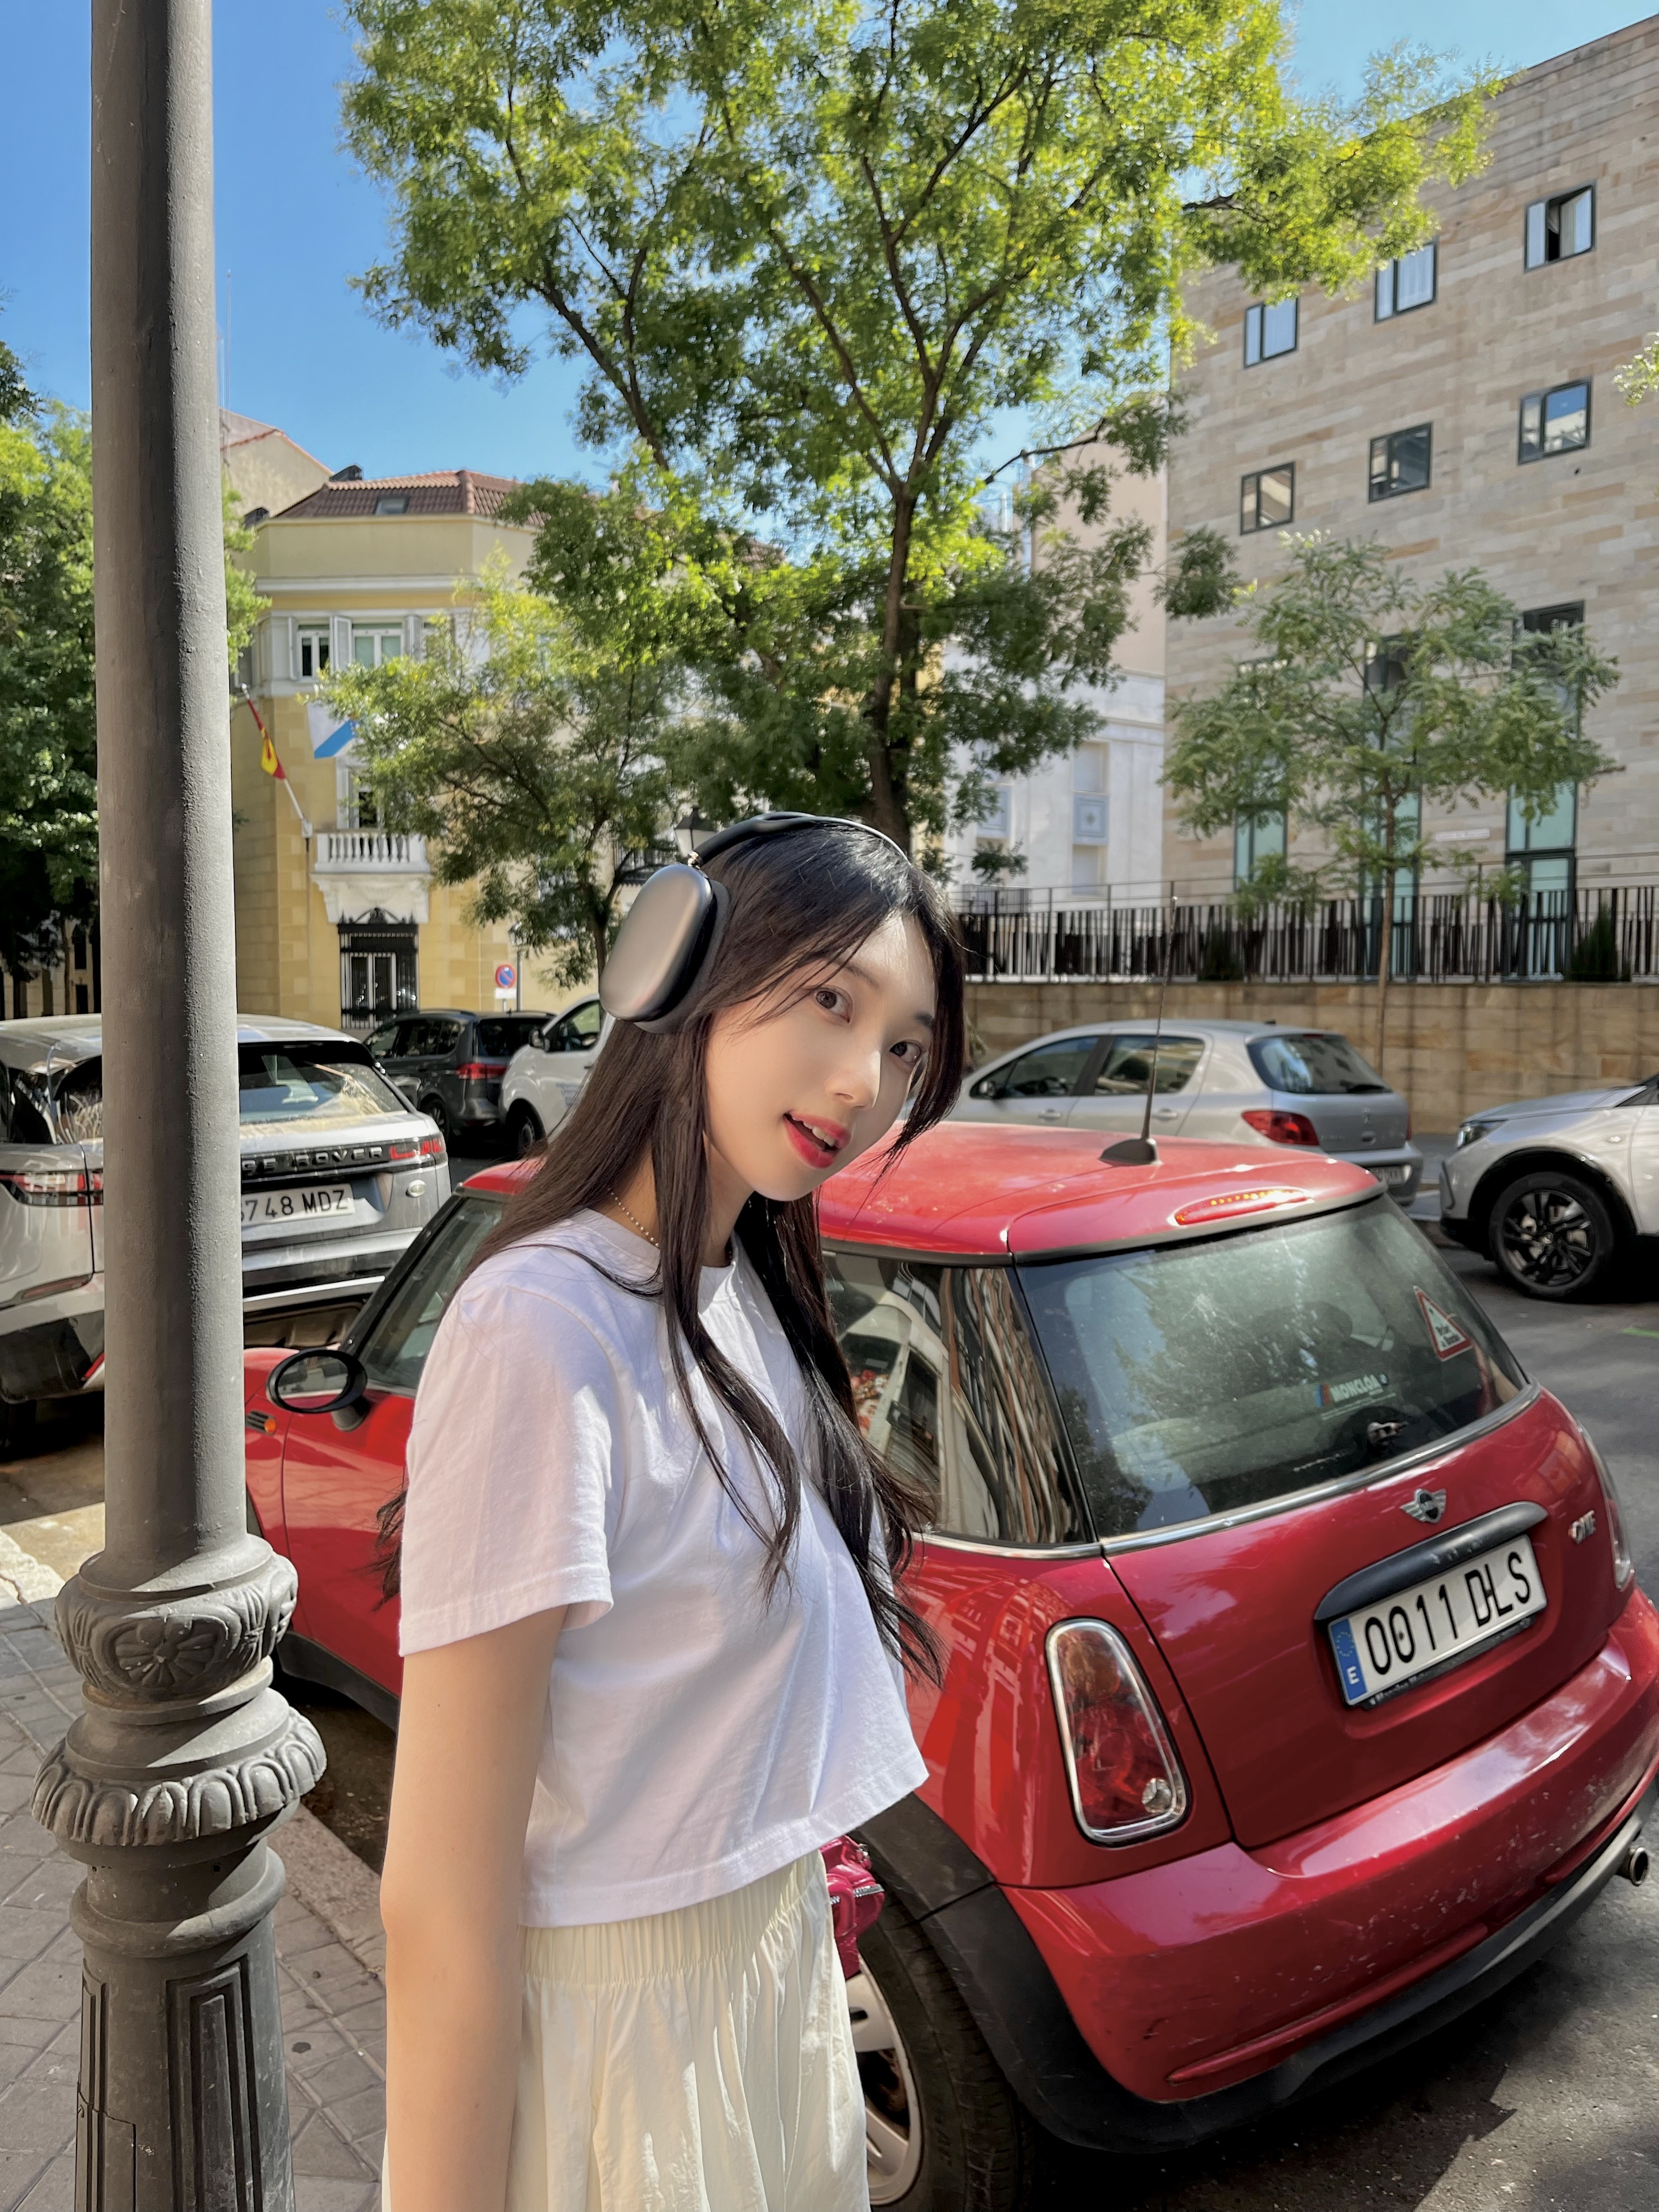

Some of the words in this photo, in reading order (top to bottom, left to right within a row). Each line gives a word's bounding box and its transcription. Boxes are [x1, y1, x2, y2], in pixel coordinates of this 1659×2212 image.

[295, 1146, 384, 1166] ROVER
[302, 1190, 349, 1214] MDZ
[1365, 1584, 1459, 1675] 0011
[1464, 1552, 1530, 1627] DLS
[1346, 1665, 1360, 1685] E
